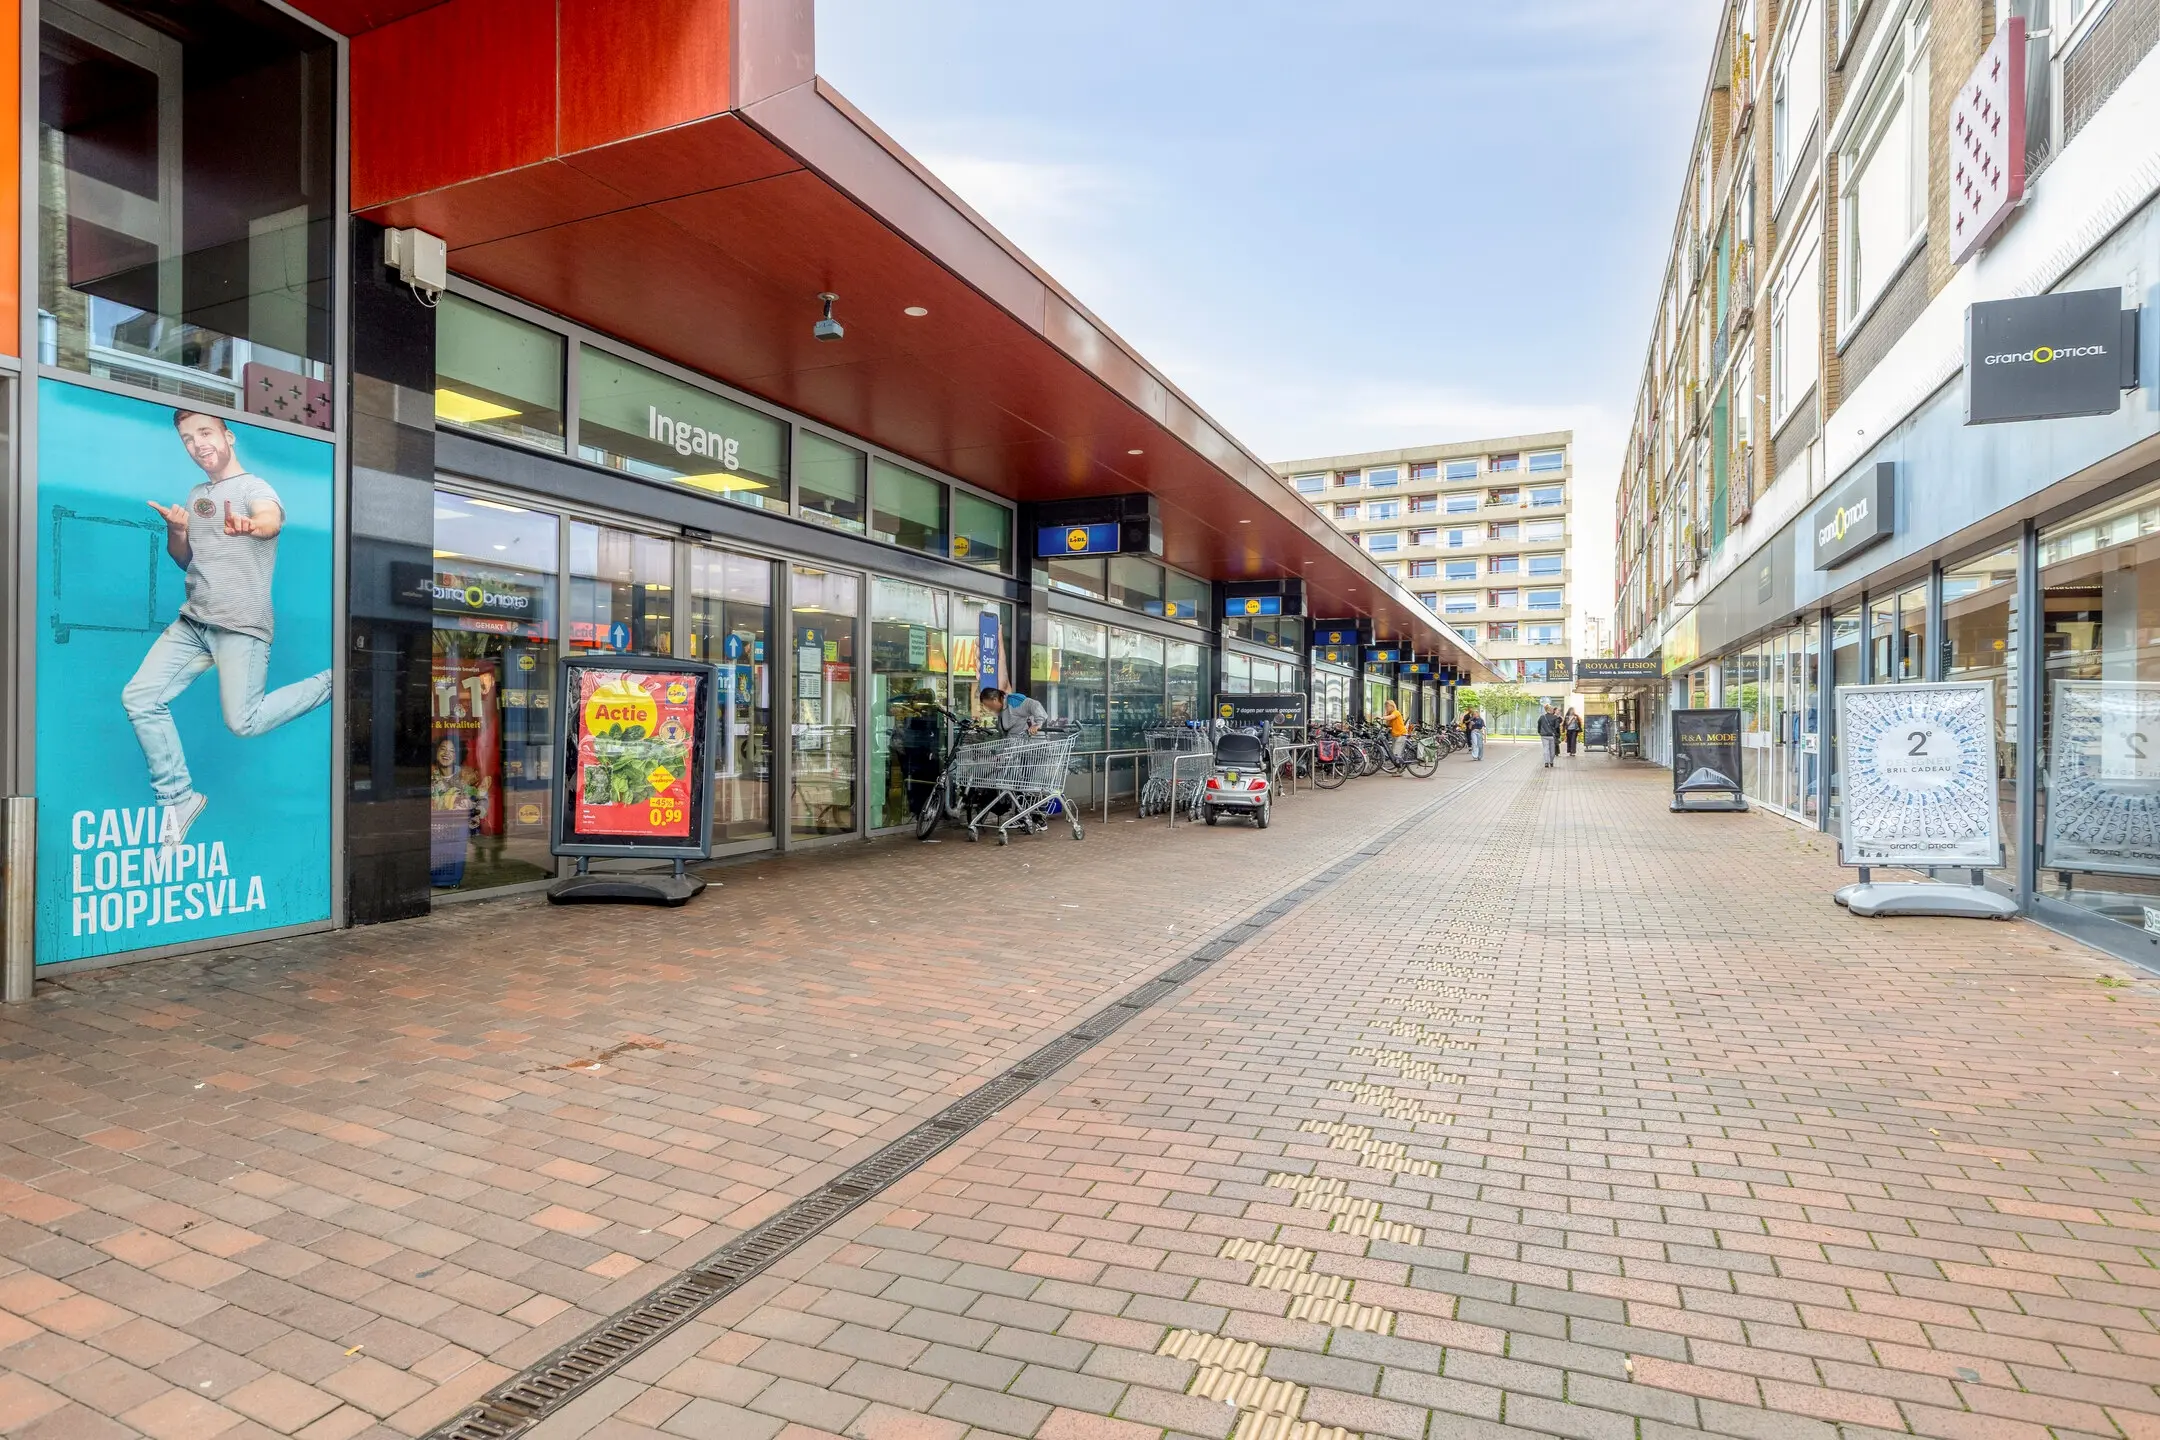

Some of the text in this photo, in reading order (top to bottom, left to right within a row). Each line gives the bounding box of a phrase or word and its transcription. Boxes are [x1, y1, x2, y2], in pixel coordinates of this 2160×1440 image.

[649, 405, 739, 470] Ingang
[475, 621, 504, 631] GEHAKT
[982, 655, 996, 664] Scan
[982, 665, 995, 674] &Go
[595, 704, 648, 722] Actie
[443, 720, 481, 729] kwaliteit
[1681, 733, 1737, 742] R&A MODE
[1886, 765, 1951, 774] BRIL CADEAU
[651, 799, 673, 807] -45%
[650, 808, 682, 826] 0.99
[72, 805, 182, 851] CAVIA
[73, 841, 229, 894] LOEMPIA
[73, 875, 267, 937] HOPJESVLA
